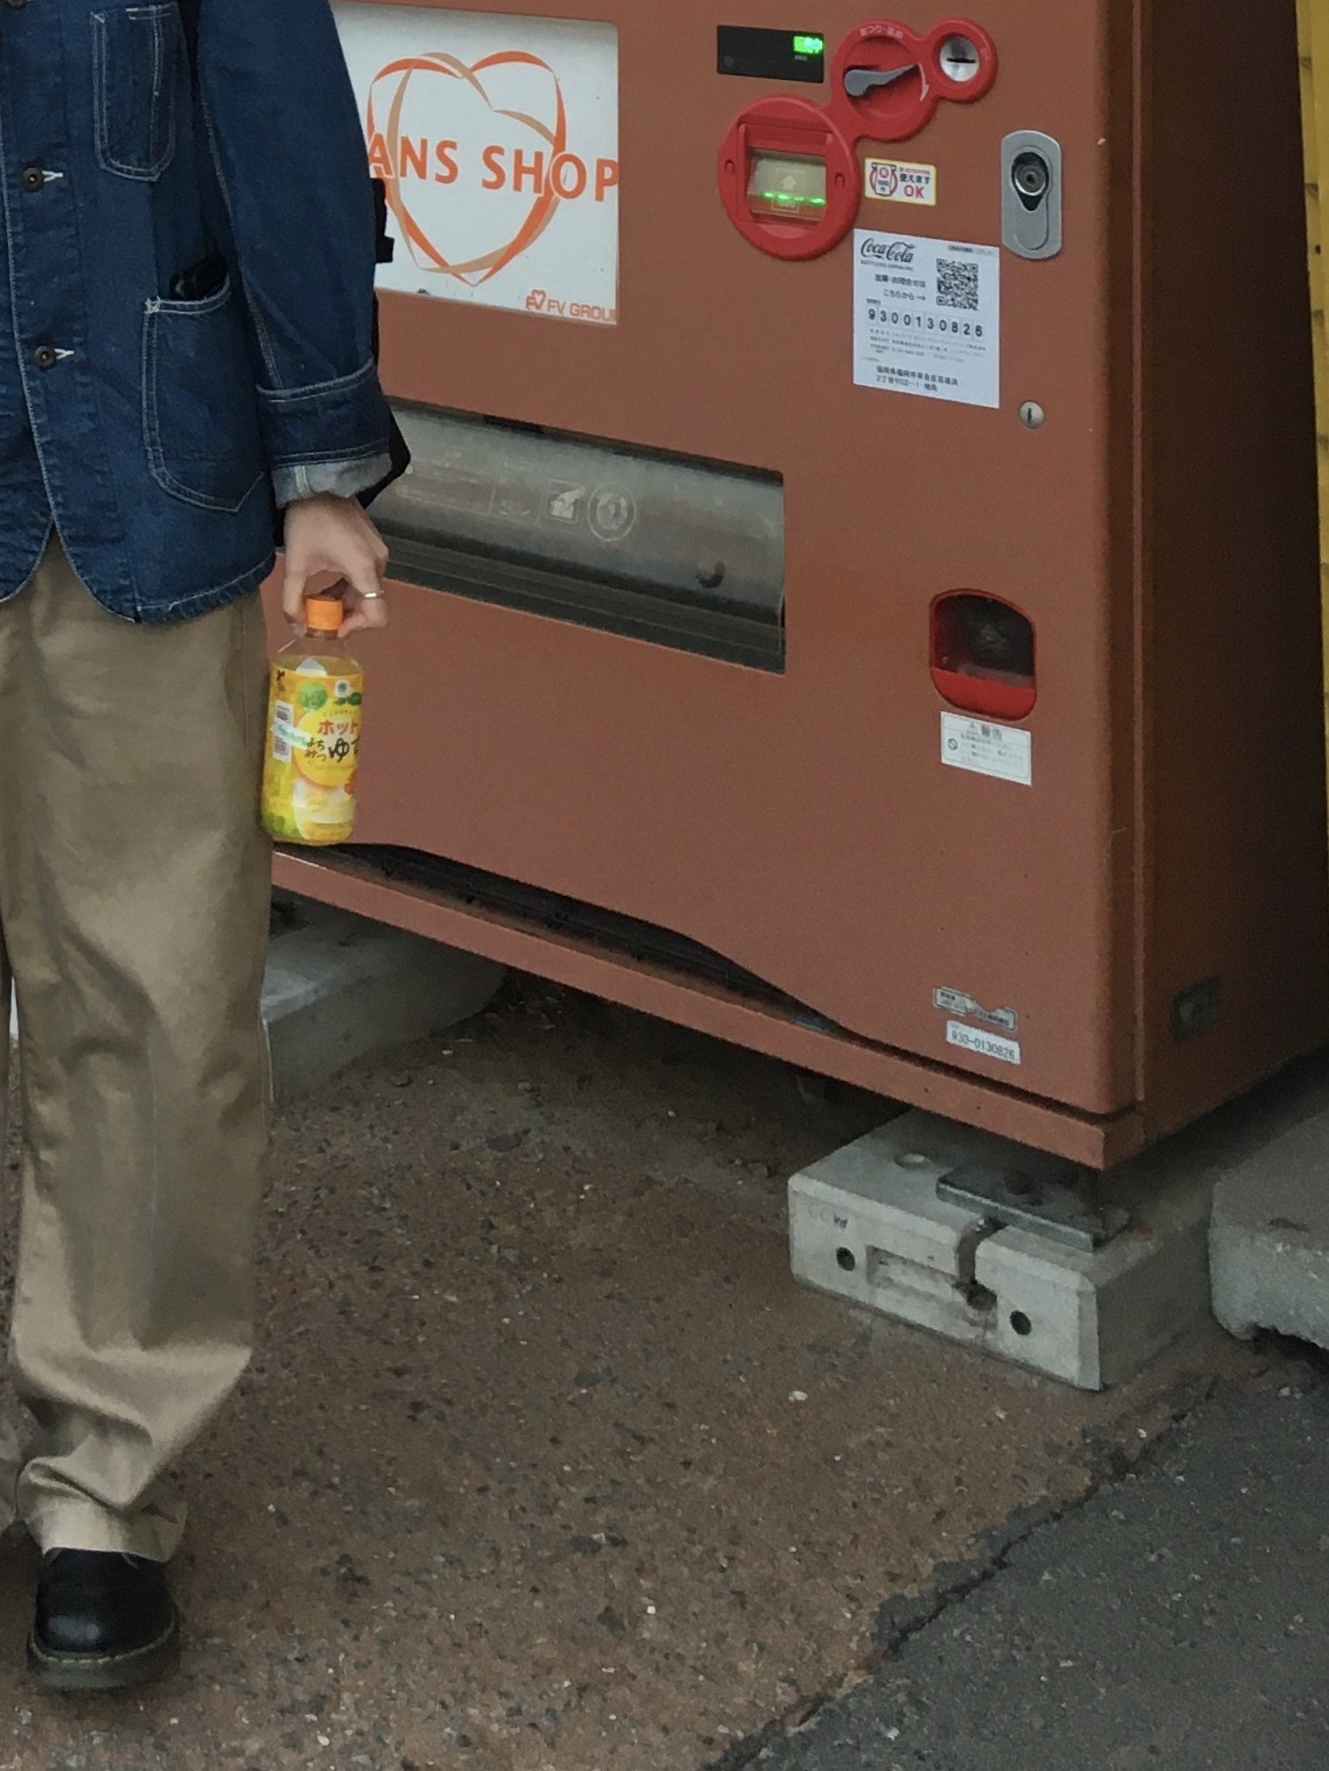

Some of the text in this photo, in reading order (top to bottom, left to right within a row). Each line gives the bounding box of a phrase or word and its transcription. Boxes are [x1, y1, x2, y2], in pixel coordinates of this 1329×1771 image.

[368, 132, 620, 203] ANS SHOP
[904, 184, 925, 199] OK
[860, 237, 916, 263] Coca-Cola
[547, 299, 566, 317] FV
[868, 308, 983, 337] 9300130826
[318, 719, 359, 736] ホット
